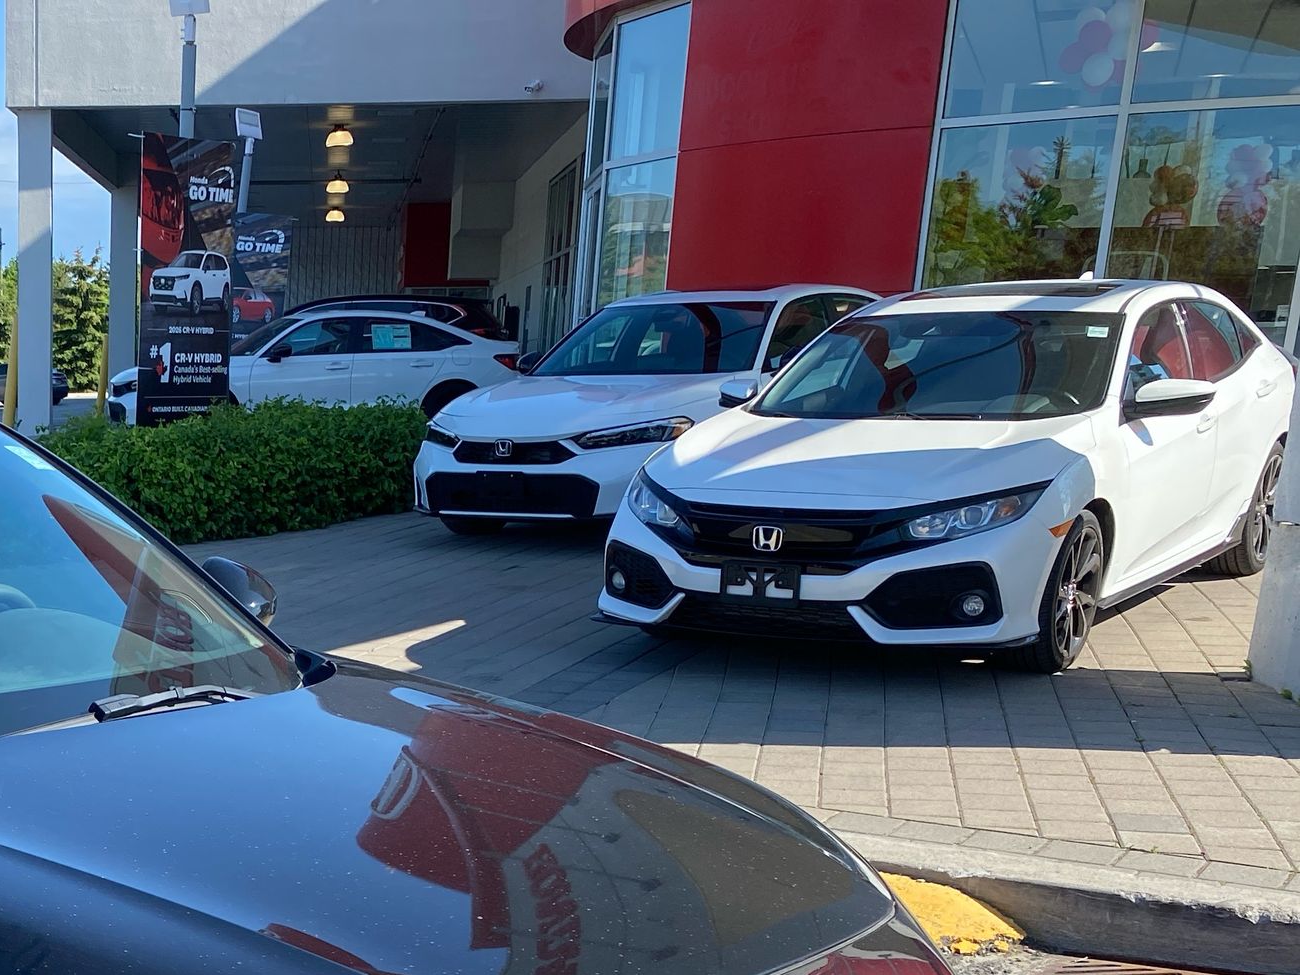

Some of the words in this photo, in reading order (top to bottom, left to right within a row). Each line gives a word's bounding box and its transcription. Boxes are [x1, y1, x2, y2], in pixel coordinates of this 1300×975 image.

[189, 185, 207, 201] GO
[208, 186, 234, 203] TIME
[236, 241, 254, 252] GO
[255, 242, 283, 254] TIME
[195, 327, 215, 335] HYBRID
[174, 352, 193, 363] CR-V
[194, 353, 222, 364] HYBRID
[173, 365, 199, 374] Canada's
[199, 365, 228, 376] Best-selling
[172, 375, 192, 385] Hybrid
